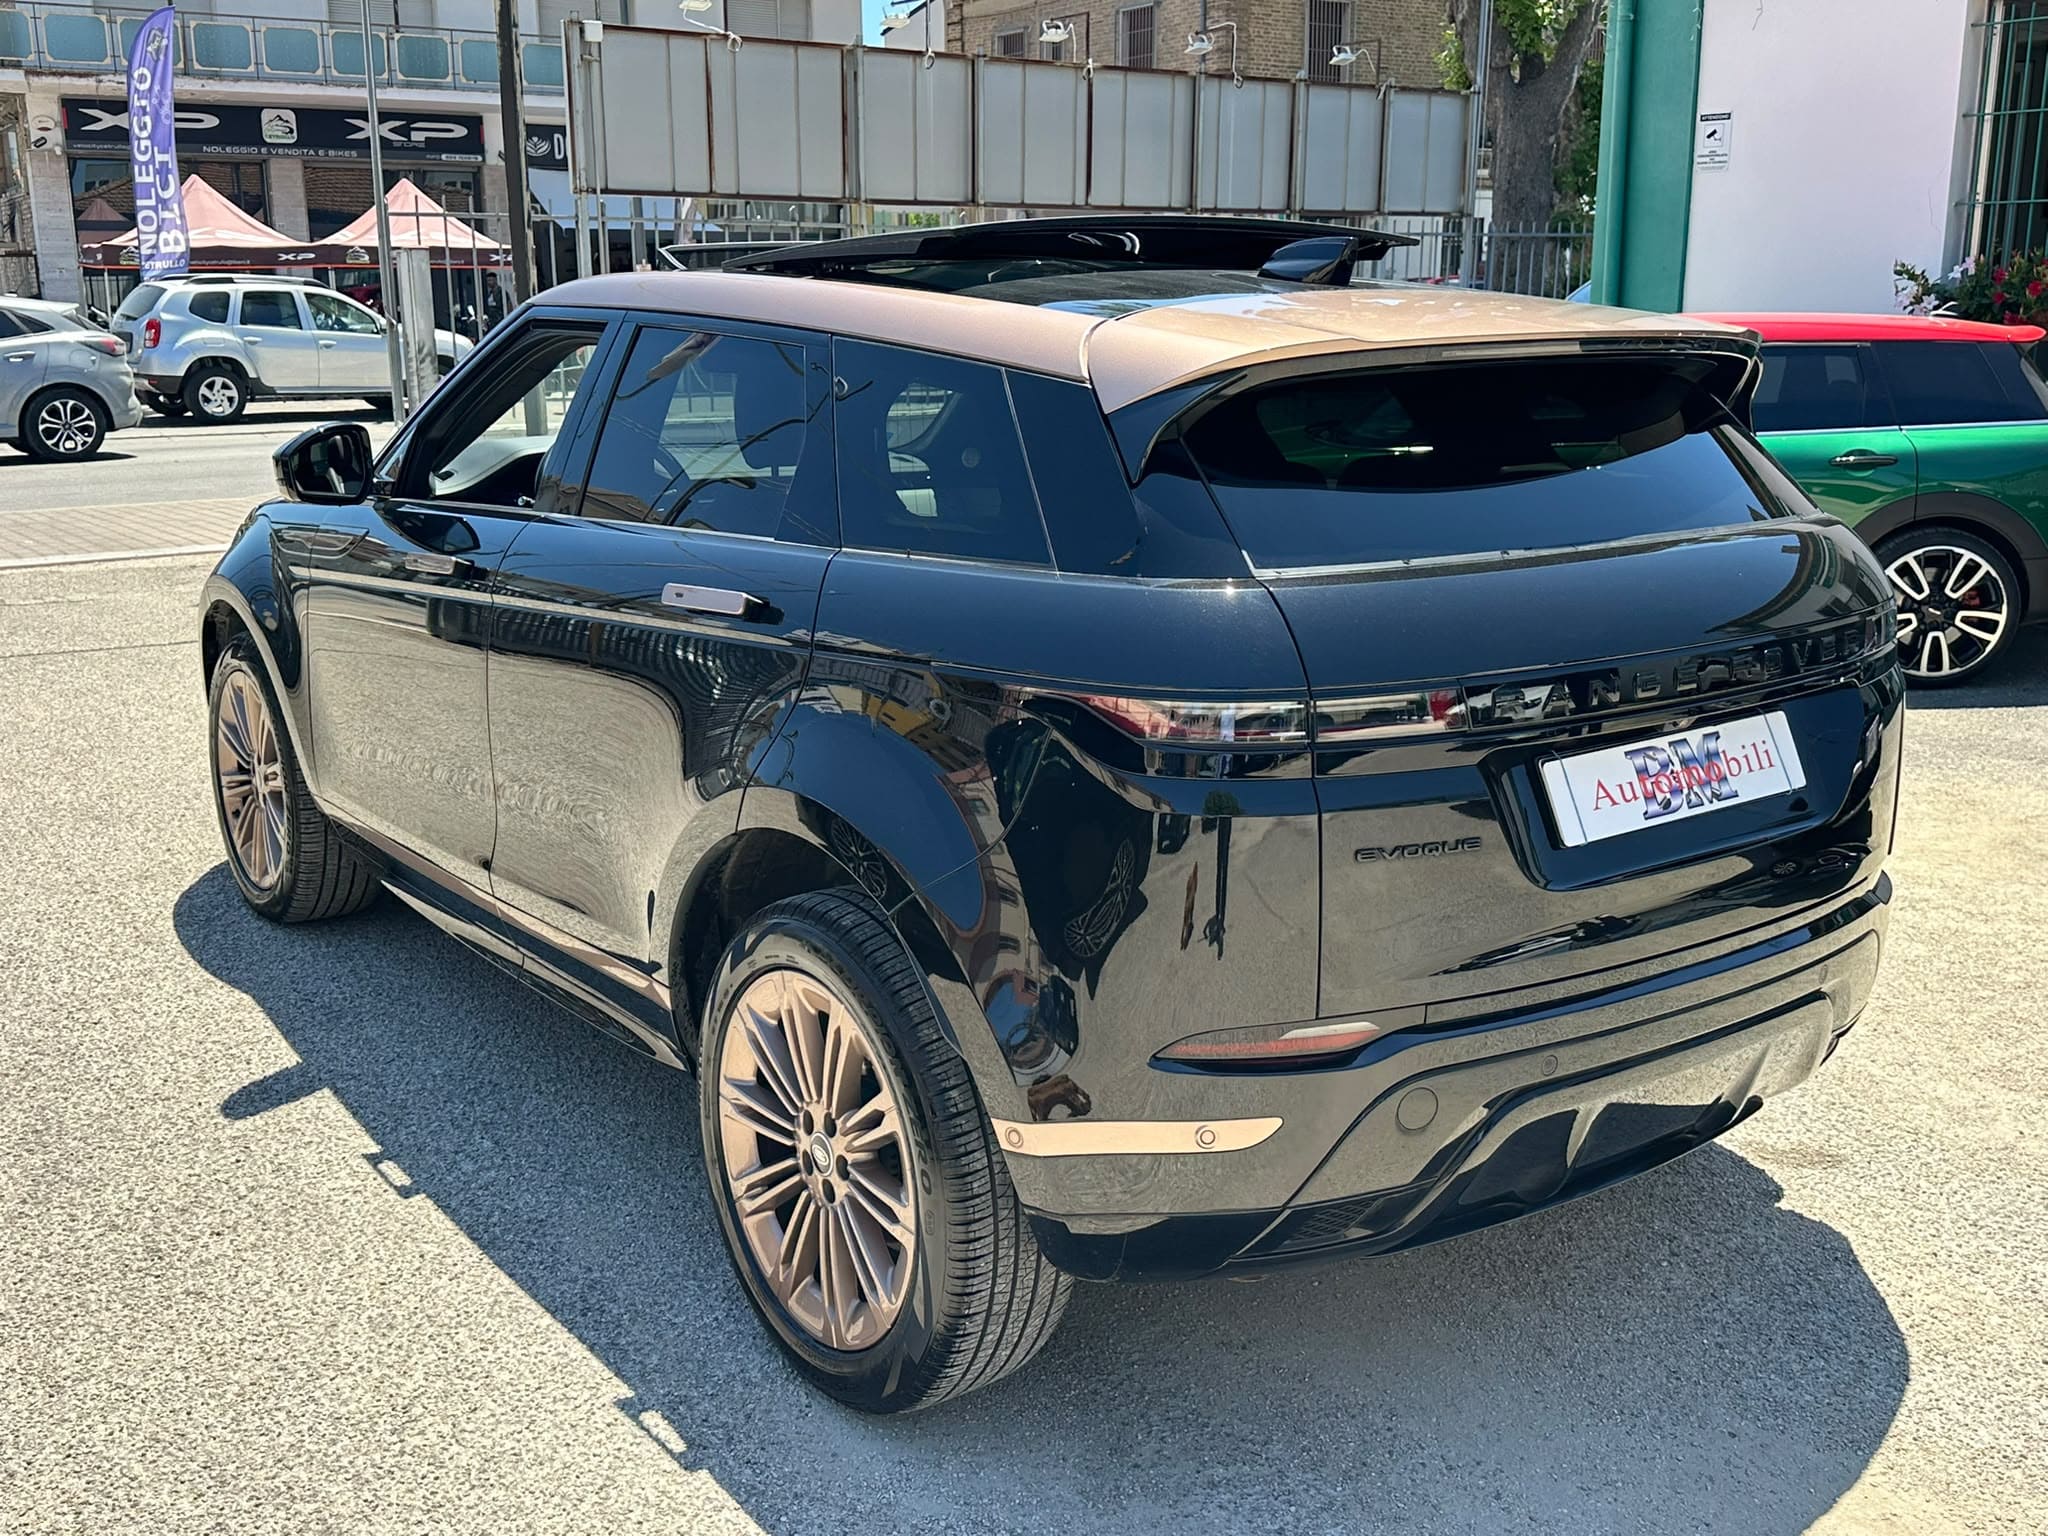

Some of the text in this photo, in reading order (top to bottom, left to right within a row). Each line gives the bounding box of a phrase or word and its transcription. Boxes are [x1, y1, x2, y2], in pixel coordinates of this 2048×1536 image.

[203, 145, 258, 154] NOLEGGIO
[261, 146, 268, 154] E
[270, 147, 315, 156] VENDITA
[344, 118, 468, 141] XP
[133, 67, 157, 255] NOLEGGIO
[154, 146, 186, 254] BICI
[277, 252, 316, 261] XP
[1491, 661, 1699, 719] RANGE
[1592, 739, 1776, 811] Automobili
[1624, 731, 1739, 821] BM
[1354, 836, 1481, 863] EVOQUE
